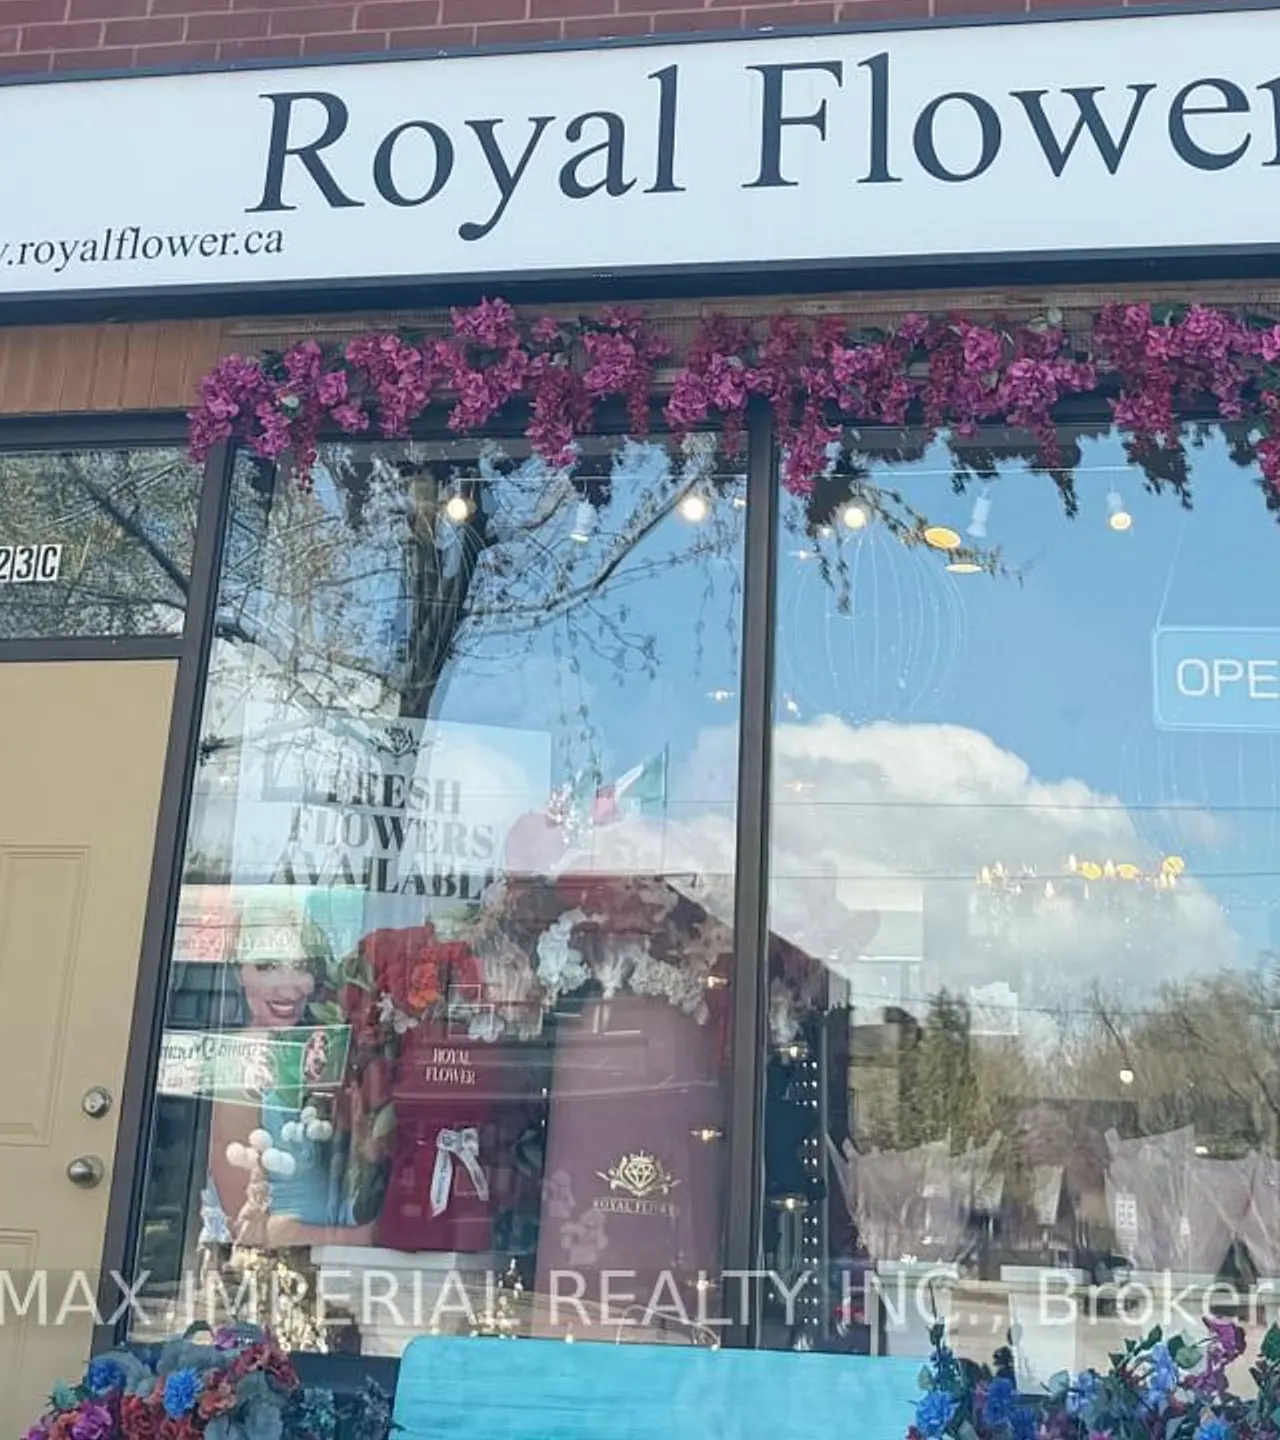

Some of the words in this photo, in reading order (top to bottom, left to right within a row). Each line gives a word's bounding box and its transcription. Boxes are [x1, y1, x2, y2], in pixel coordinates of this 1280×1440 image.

[244, 64, 686, 241] Royal
[326, 770, 462, 814] FRESH
[288, 806, 496, 860] FLOWERS
[425, 1067, 477, 1085] FLOWER
